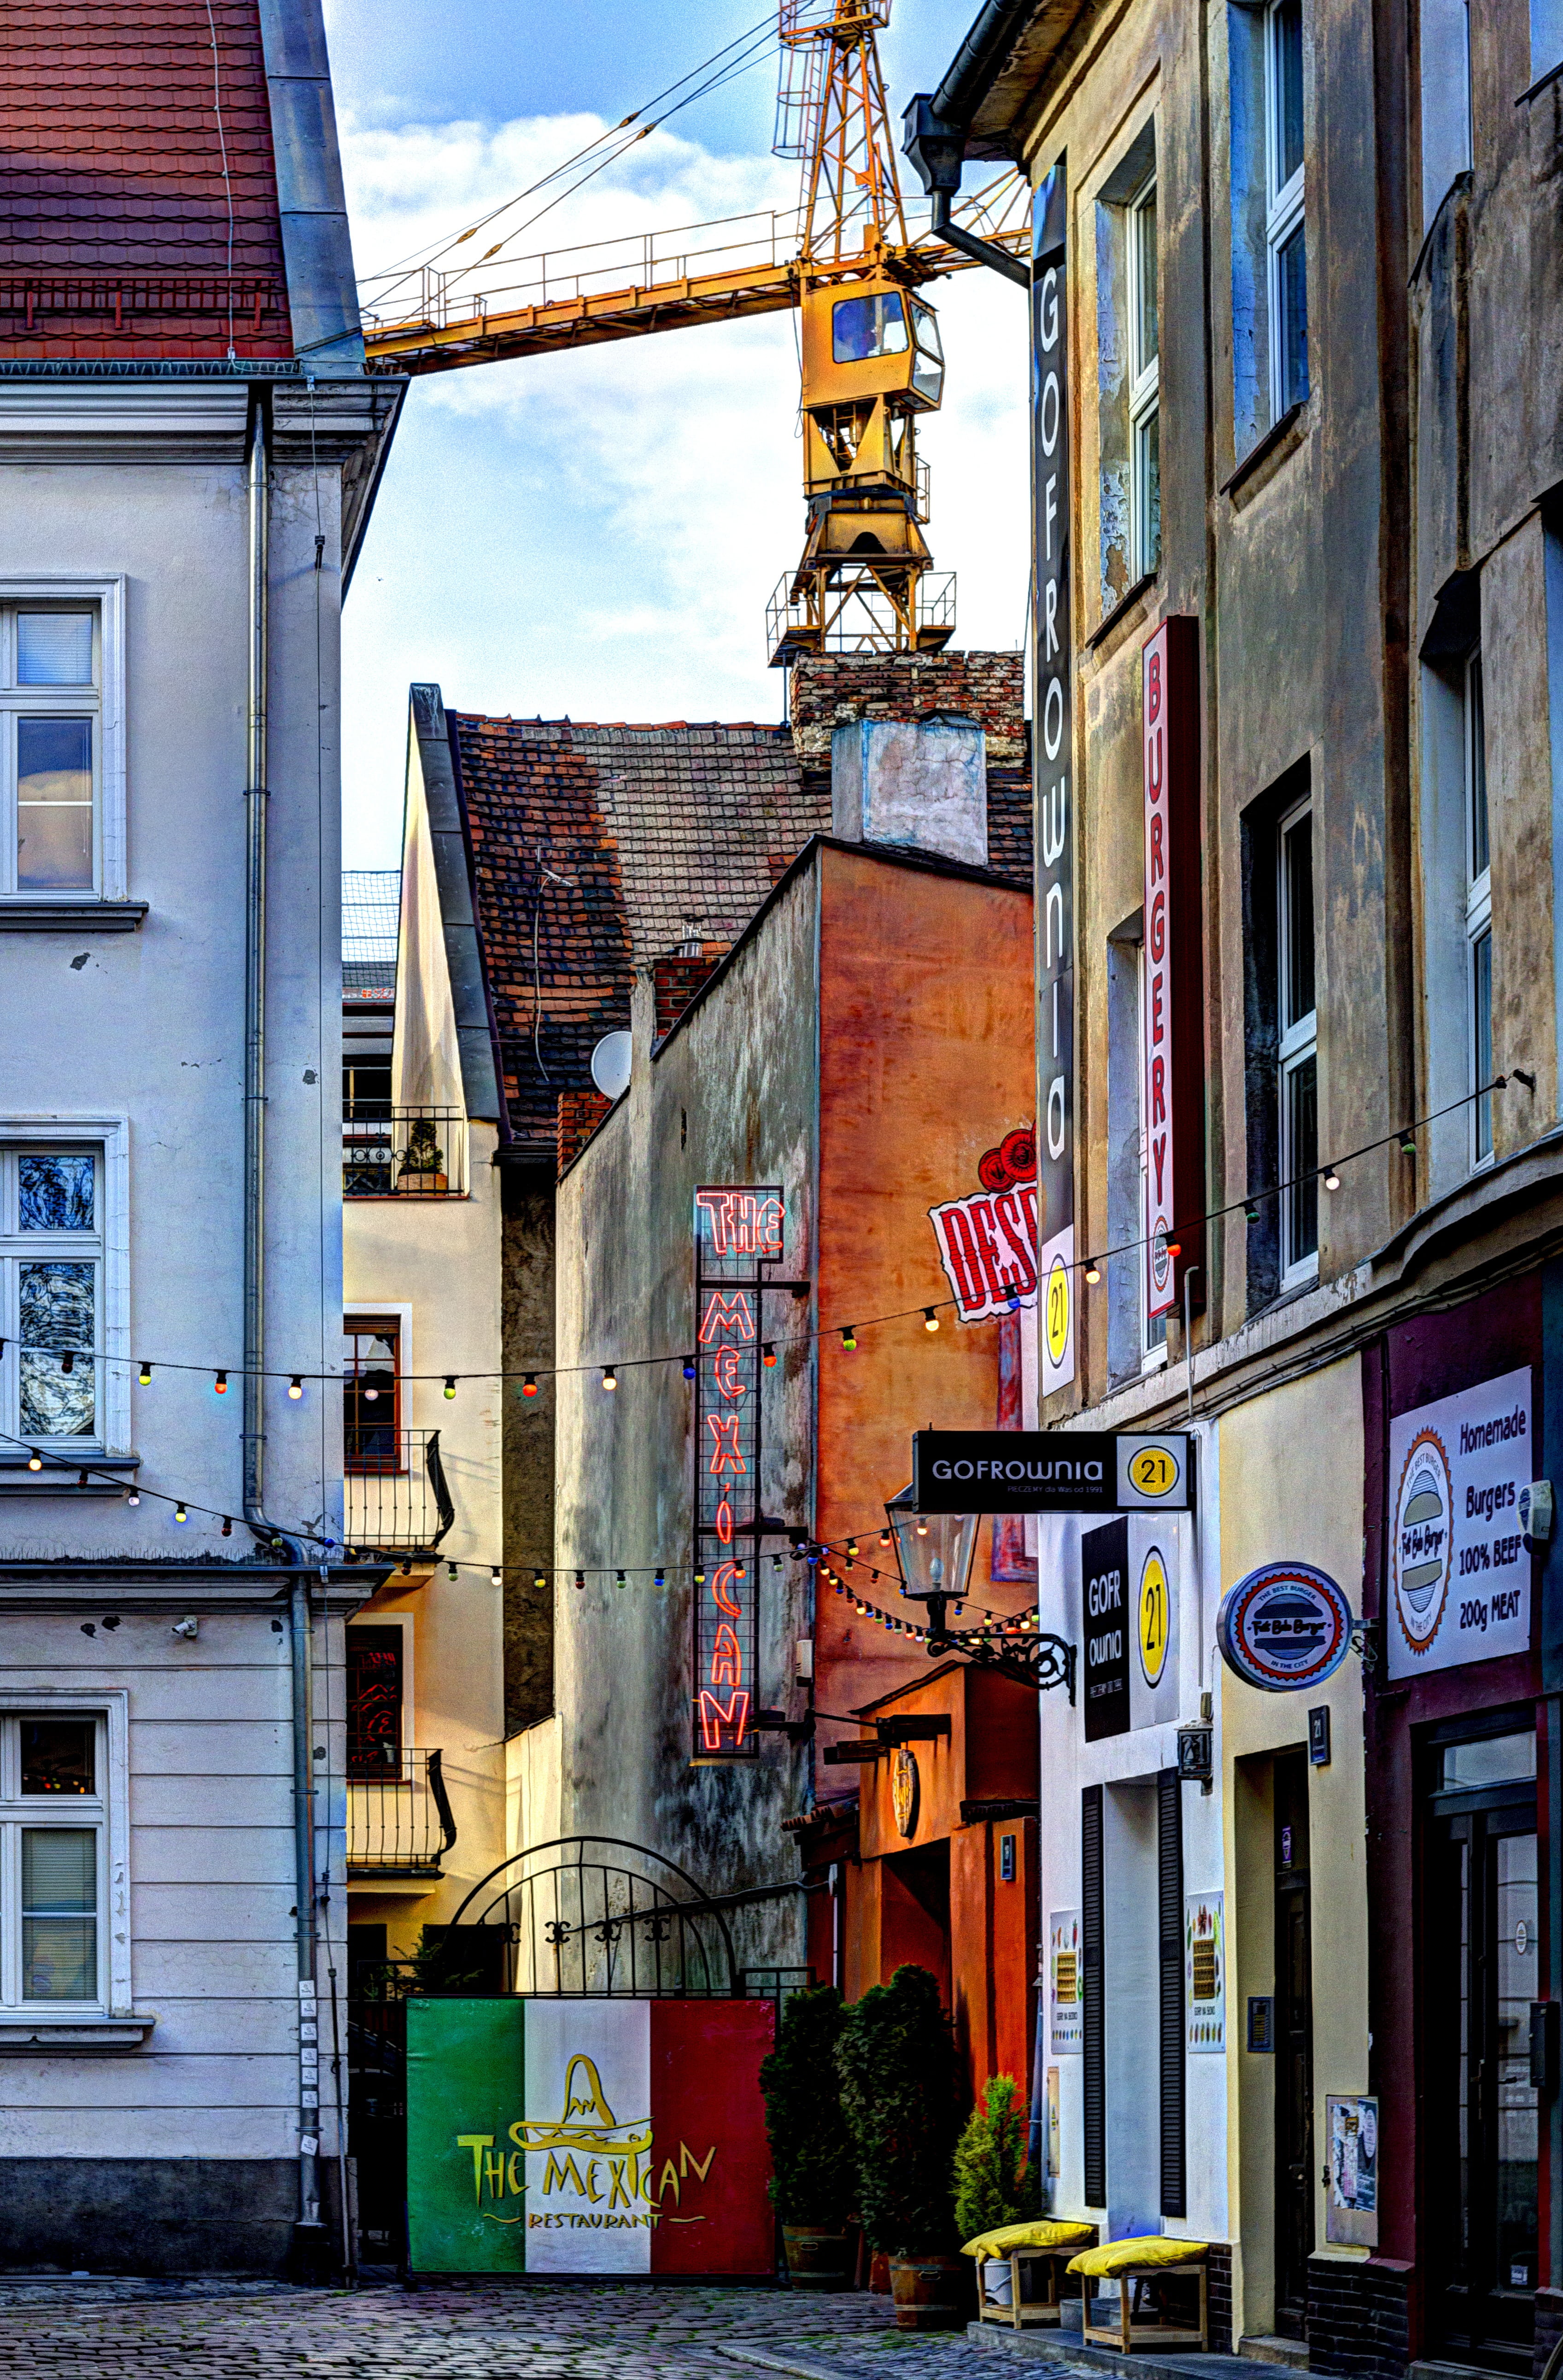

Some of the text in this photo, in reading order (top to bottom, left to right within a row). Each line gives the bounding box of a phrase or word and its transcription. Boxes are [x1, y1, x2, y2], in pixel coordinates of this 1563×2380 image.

[1148, 651, 1166, 1207] BURGERY
[696, 1192, 786, 1254] THE
[1051, 1282, 1063, 1338] 21
[1459, 1404, 1526, 1456] Homemade
[1141, 1459, 1166, 1483] 21
[1406, 1453, 1441, 1489] THE BEST BURGER
[698, 1291, 755, 1749] MEXICAN
[1466, 1481, 1515, 1522] Burgers
[1459, 1534, 1522, 1576] 100% BEEF
[1089, 1569, 1122, 1617] GOFR
[1257, 1590, 1270, 1601] THE
[1290, 1585, 1317, 1600] BURGER
[1460, 1589, 1521, 1632] 200g MEAT
[1146, 1583, 1161, 1651] 21
[1294, 1659, 1309, 1668] CITY
[1182, 1734, 1205, 1764] 21
[457, 2134, 717, 2210] THE MEXICAN
[528, 2213, 664, 2229] RESTAURANT
